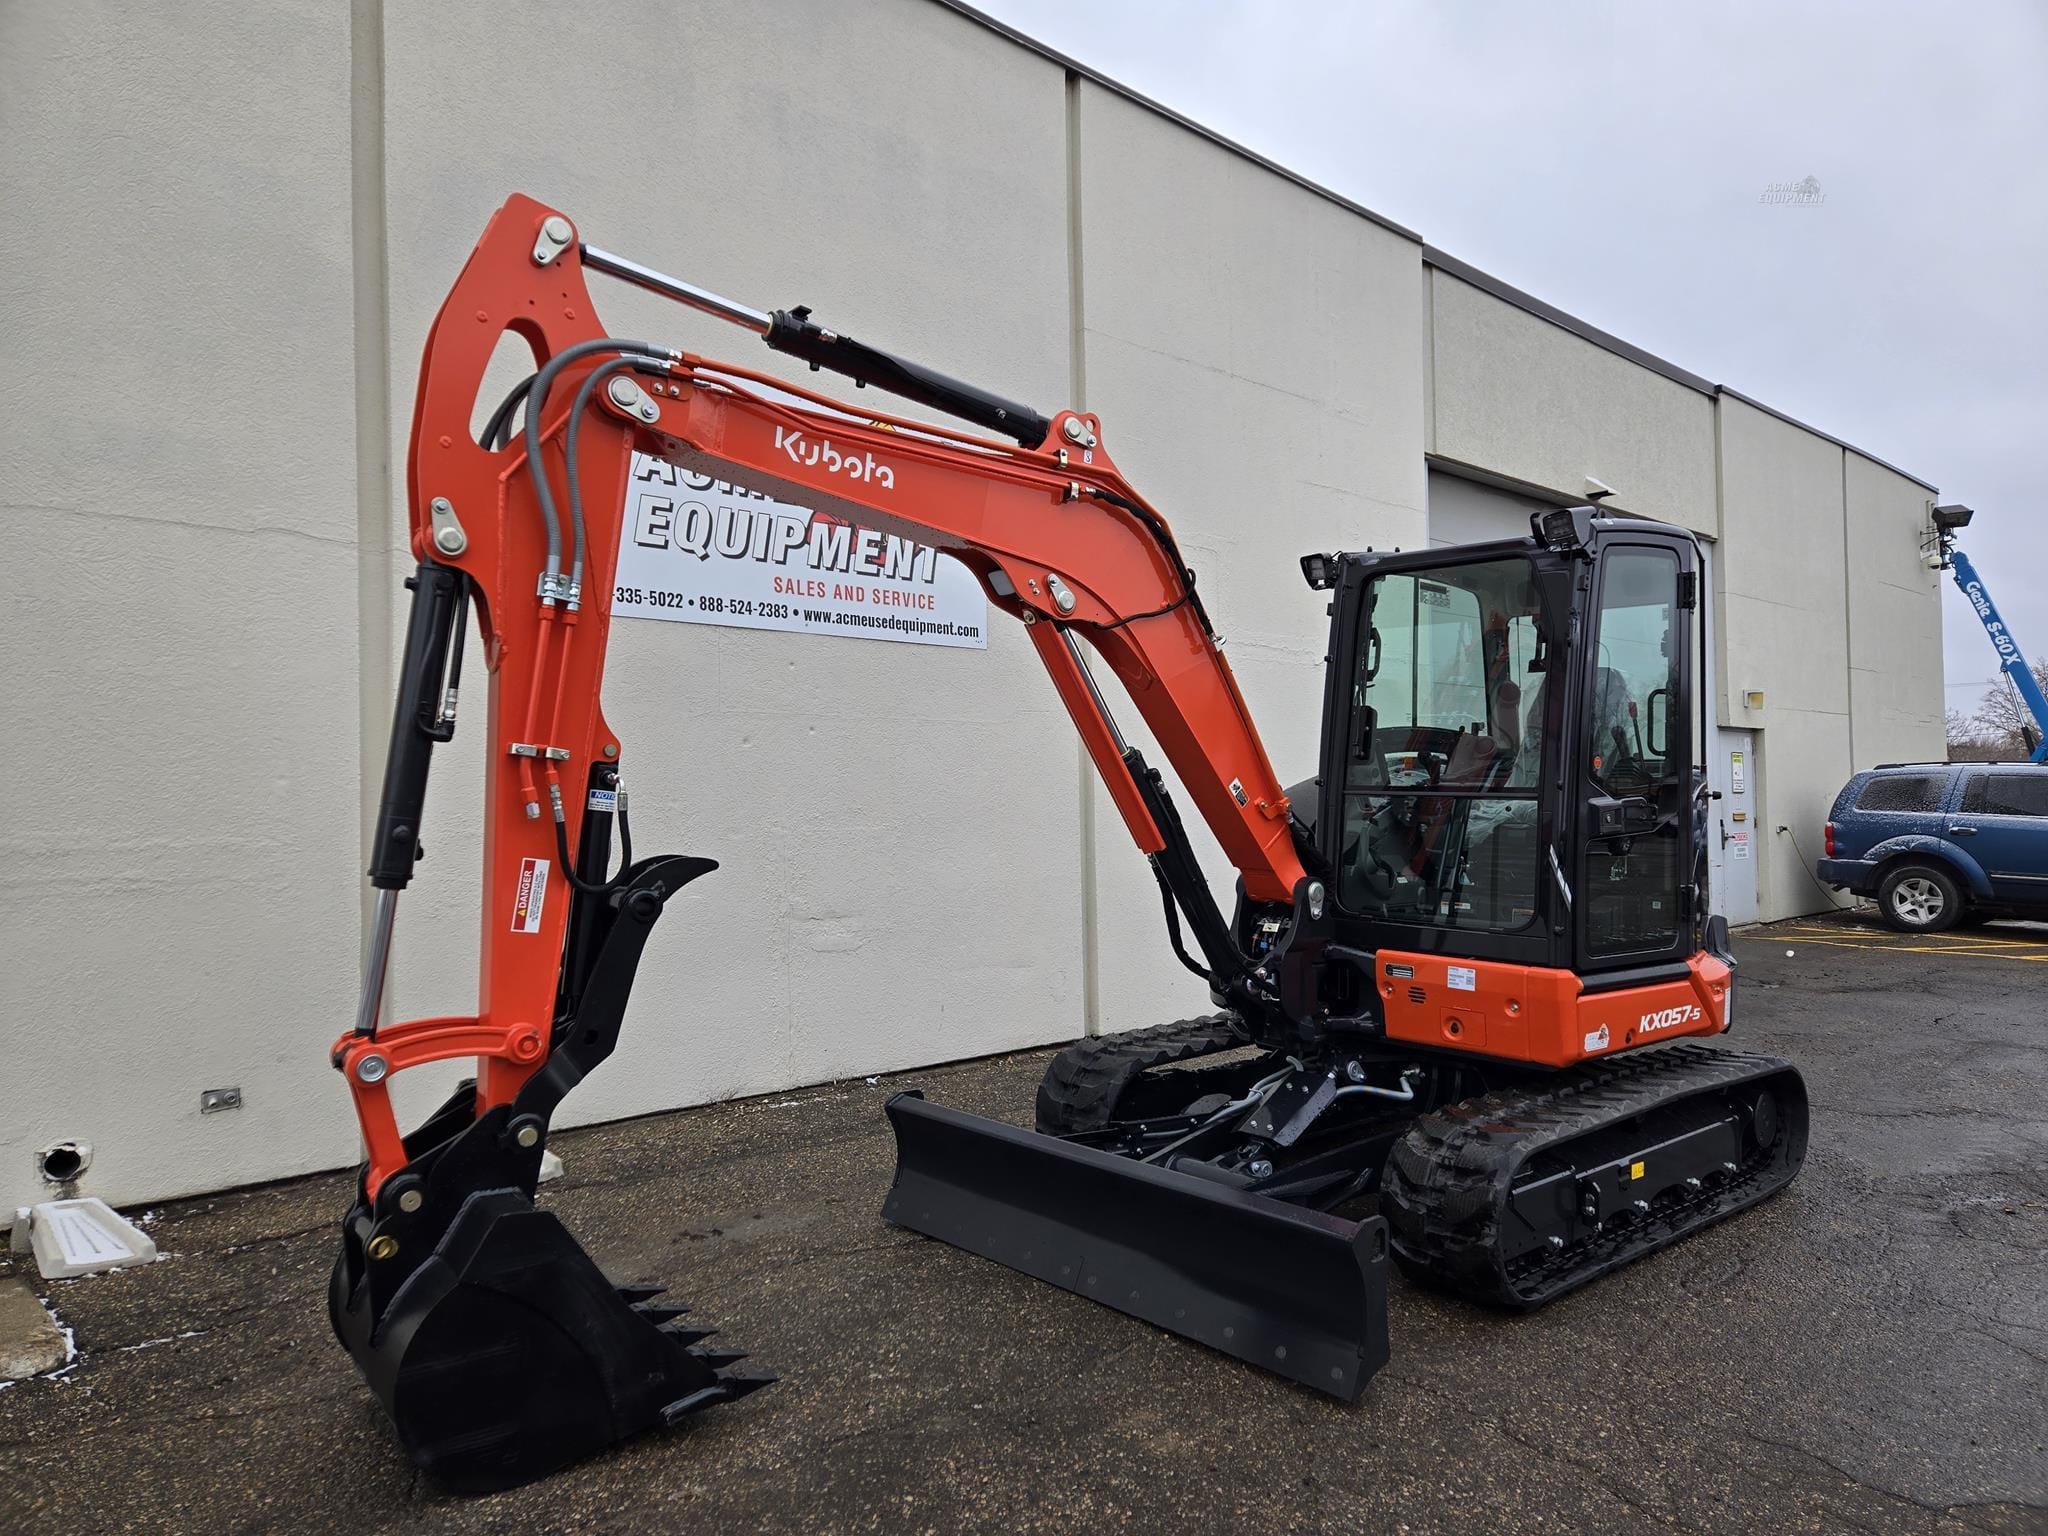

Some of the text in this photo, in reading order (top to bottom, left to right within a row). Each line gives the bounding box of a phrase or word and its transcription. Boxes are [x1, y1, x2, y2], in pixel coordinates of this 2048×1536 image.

[775, 425, 894, 490] Kubota
[633, 494, 937, 584] EQUIPMENT
[774, 576, 935, 610] SALES AND SERVICE
[699, 595, 788, 619] 888-524-2383
[803, 608, 979, 638] www.acmeusedequipment.com
[1966, 581, 2021, 666] Genie S-60X
[518, 870, 532, 909] DANGER
[1639, 1005, 1701, 1033] KX057-5
